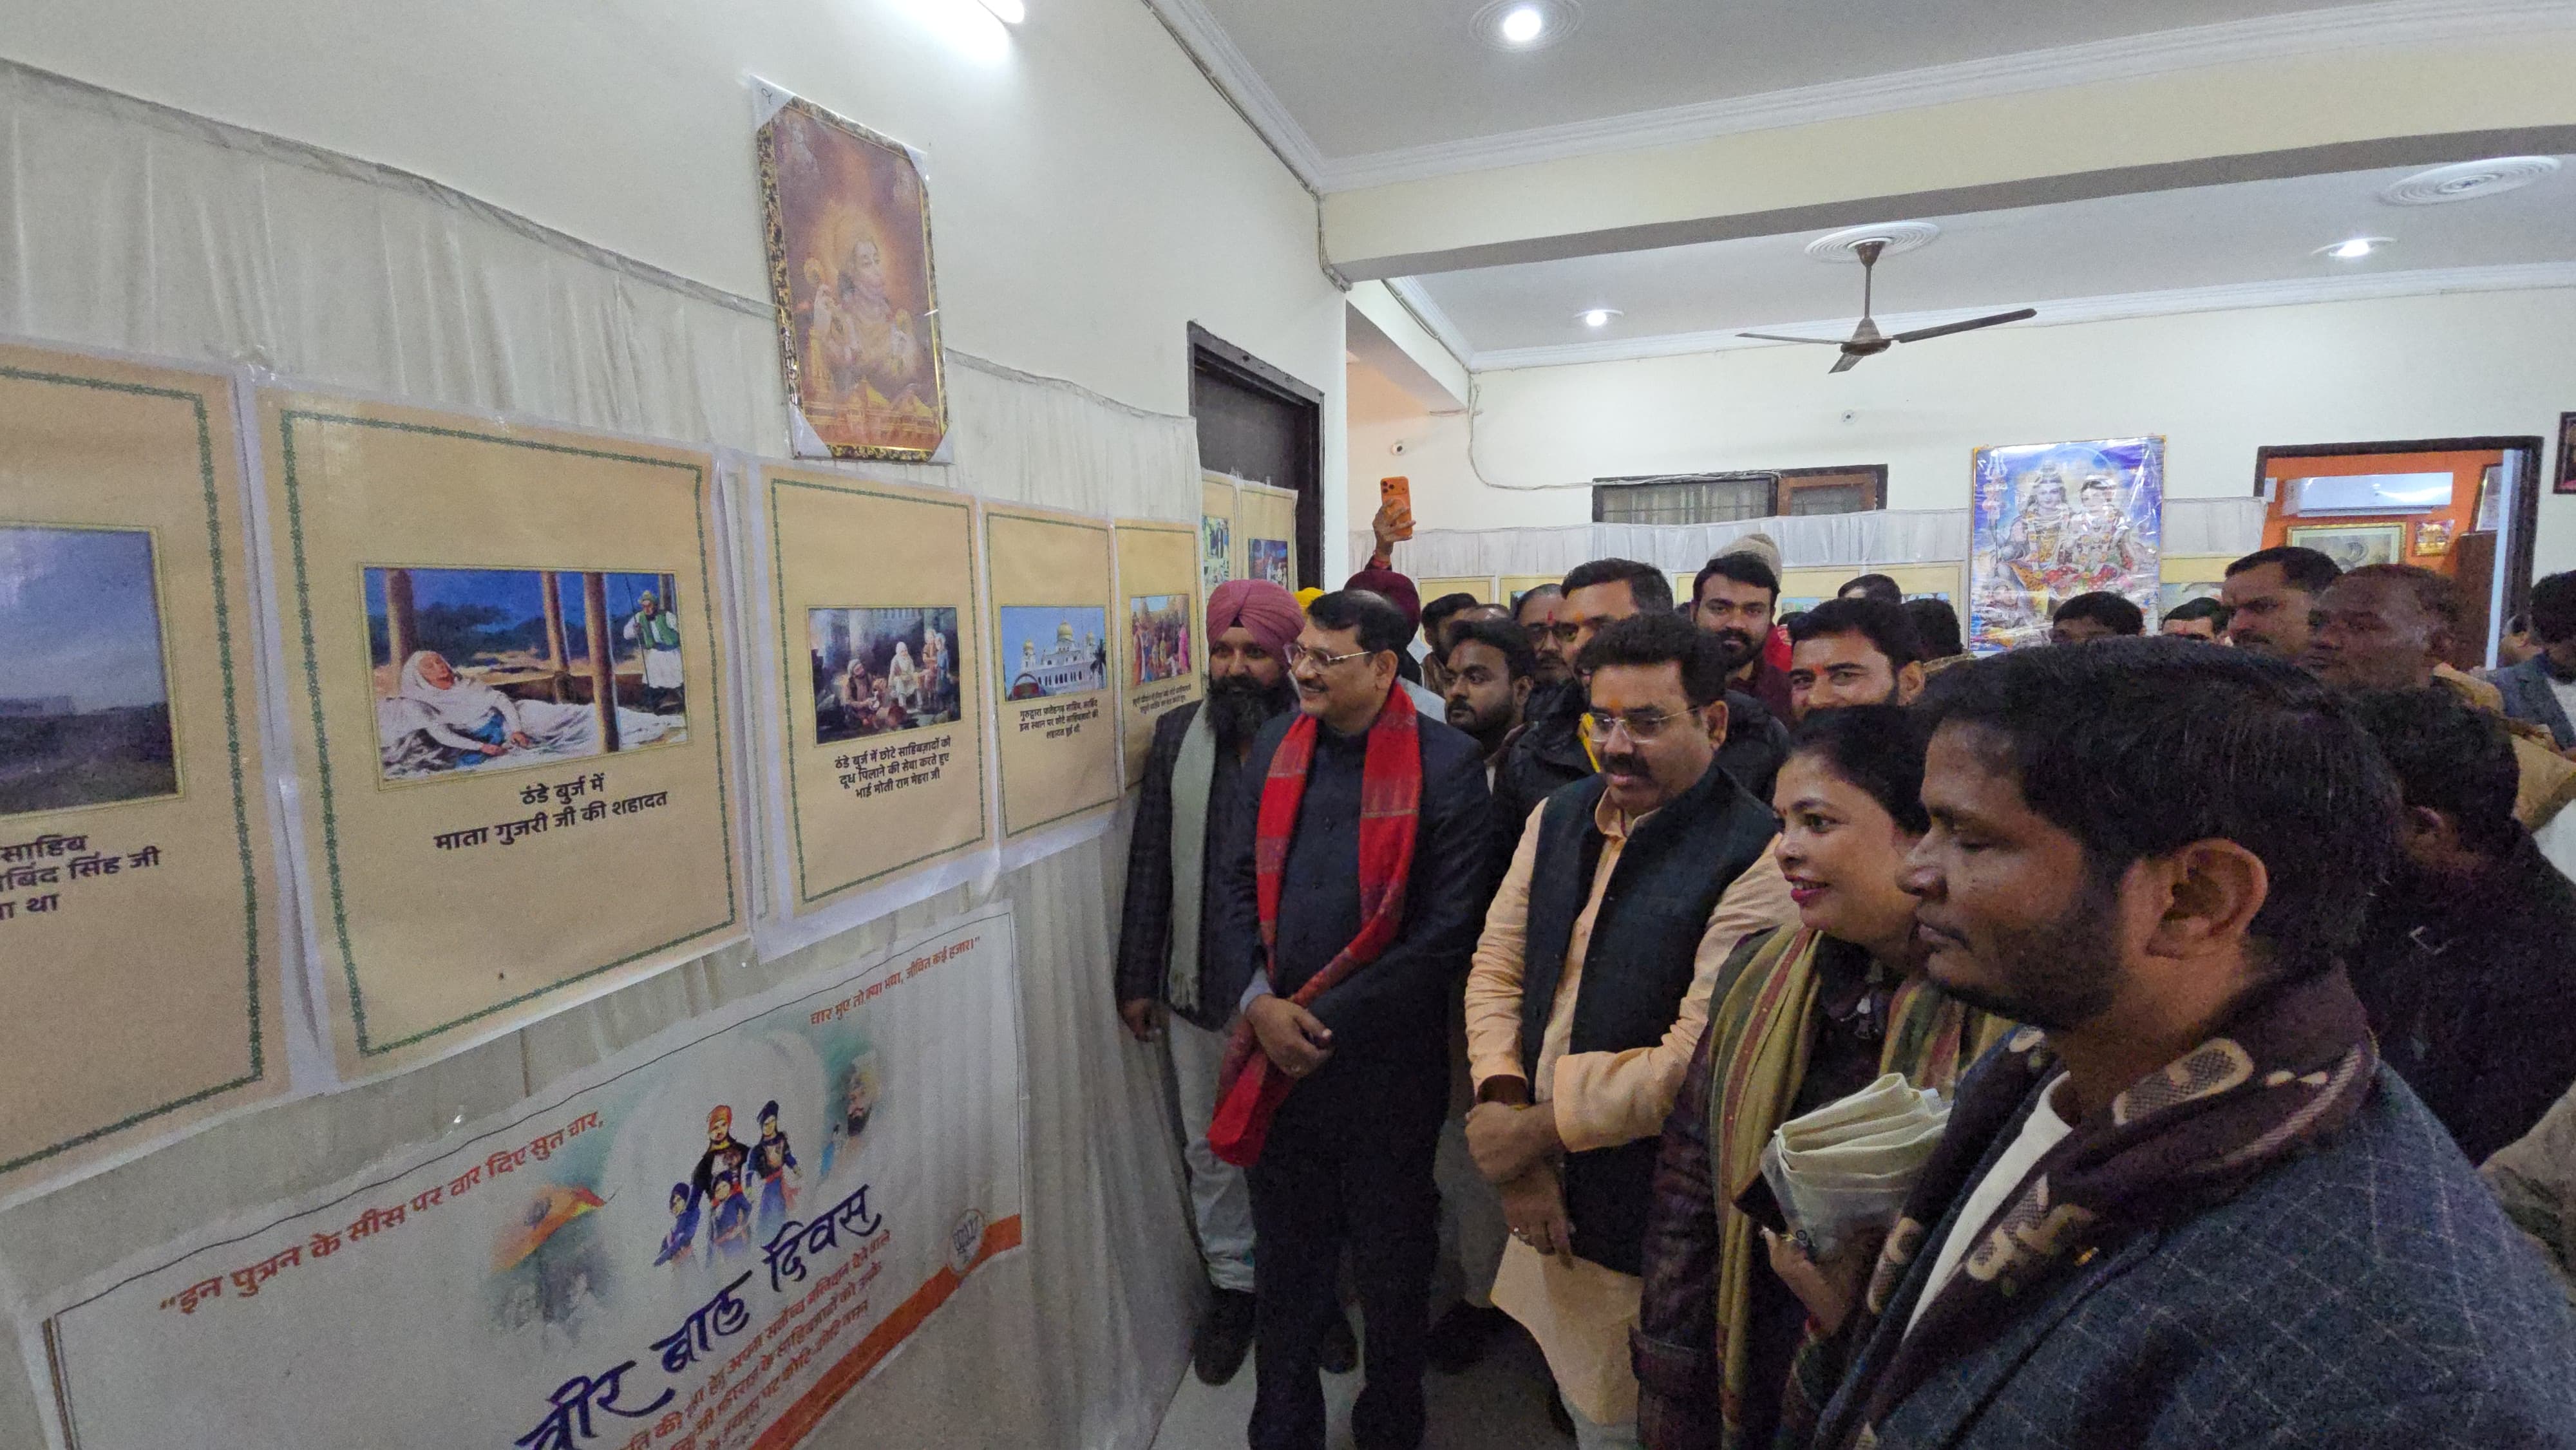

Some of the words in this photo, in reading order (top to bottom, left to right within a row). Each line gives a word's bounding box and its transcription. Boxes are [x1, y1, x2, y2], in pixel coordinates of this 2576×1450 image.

[835, 755, 849, 768] ठंडे
[879, 746, 896, 760] छोटे
[941, 735, 951, 748] को
[520, 783, 551, 805] ठंडे
[553, 775, 585, 805] बुर्ज
[589, 773, 605, 793] में
[839, 773, 855, 789] दूध
[858, 764, 885, 782] पिलाने
[887, 761, 900, 774] की
[902, 759, 917, 771] सेवा
[919, 753, 937, 766] करते
[938, 753, 949, 766] हुए
[855, 782, 872, 798] भाई
[873, 778, 894, 793] मोती
[895, 777, 909, 789] राम
[931, 767, 940, 780] जी
[433, 826, 489, 851] माता
[494, 811, 548, 846] गुजरी
[552, 806, 576, 827] जी
[581, 800, 607, 822] की
[612, 791, 668, 816] शहादत
[0, 833, 88, 862] साहिब
[0, 862, 60, 892] बिंद
[67, 851, 122, 880] सिंह
[128, 845, 162, 869] जी
[26, 894, 59, 912] था
[810, 1007, 833, 1024] चार
[835, 998, 851, 1021] मुए
[853, 989, 864, 1007] तो
[905, 957, 931, 979] जीवित
[932, 945, 947, 963] कई
[230, 1245, 303, 1298] पुत्रन
[309, 1230, 343, 1258] के
[346, 1203, 406, 1242] सीस
[410, 1185, 444, 1212] पर
[448, 1165, 482, 1197] वार
[485, 1145, 529, 1178] दिए
[529, 1128, 565, 1161] सुत
[567, 1111, 604, 1137] चार,
[514, 1360, 676, 1450] वीर
[648, 1269, 753, 1373] बाल
[761, 1183, 882, 1293] दिवस
